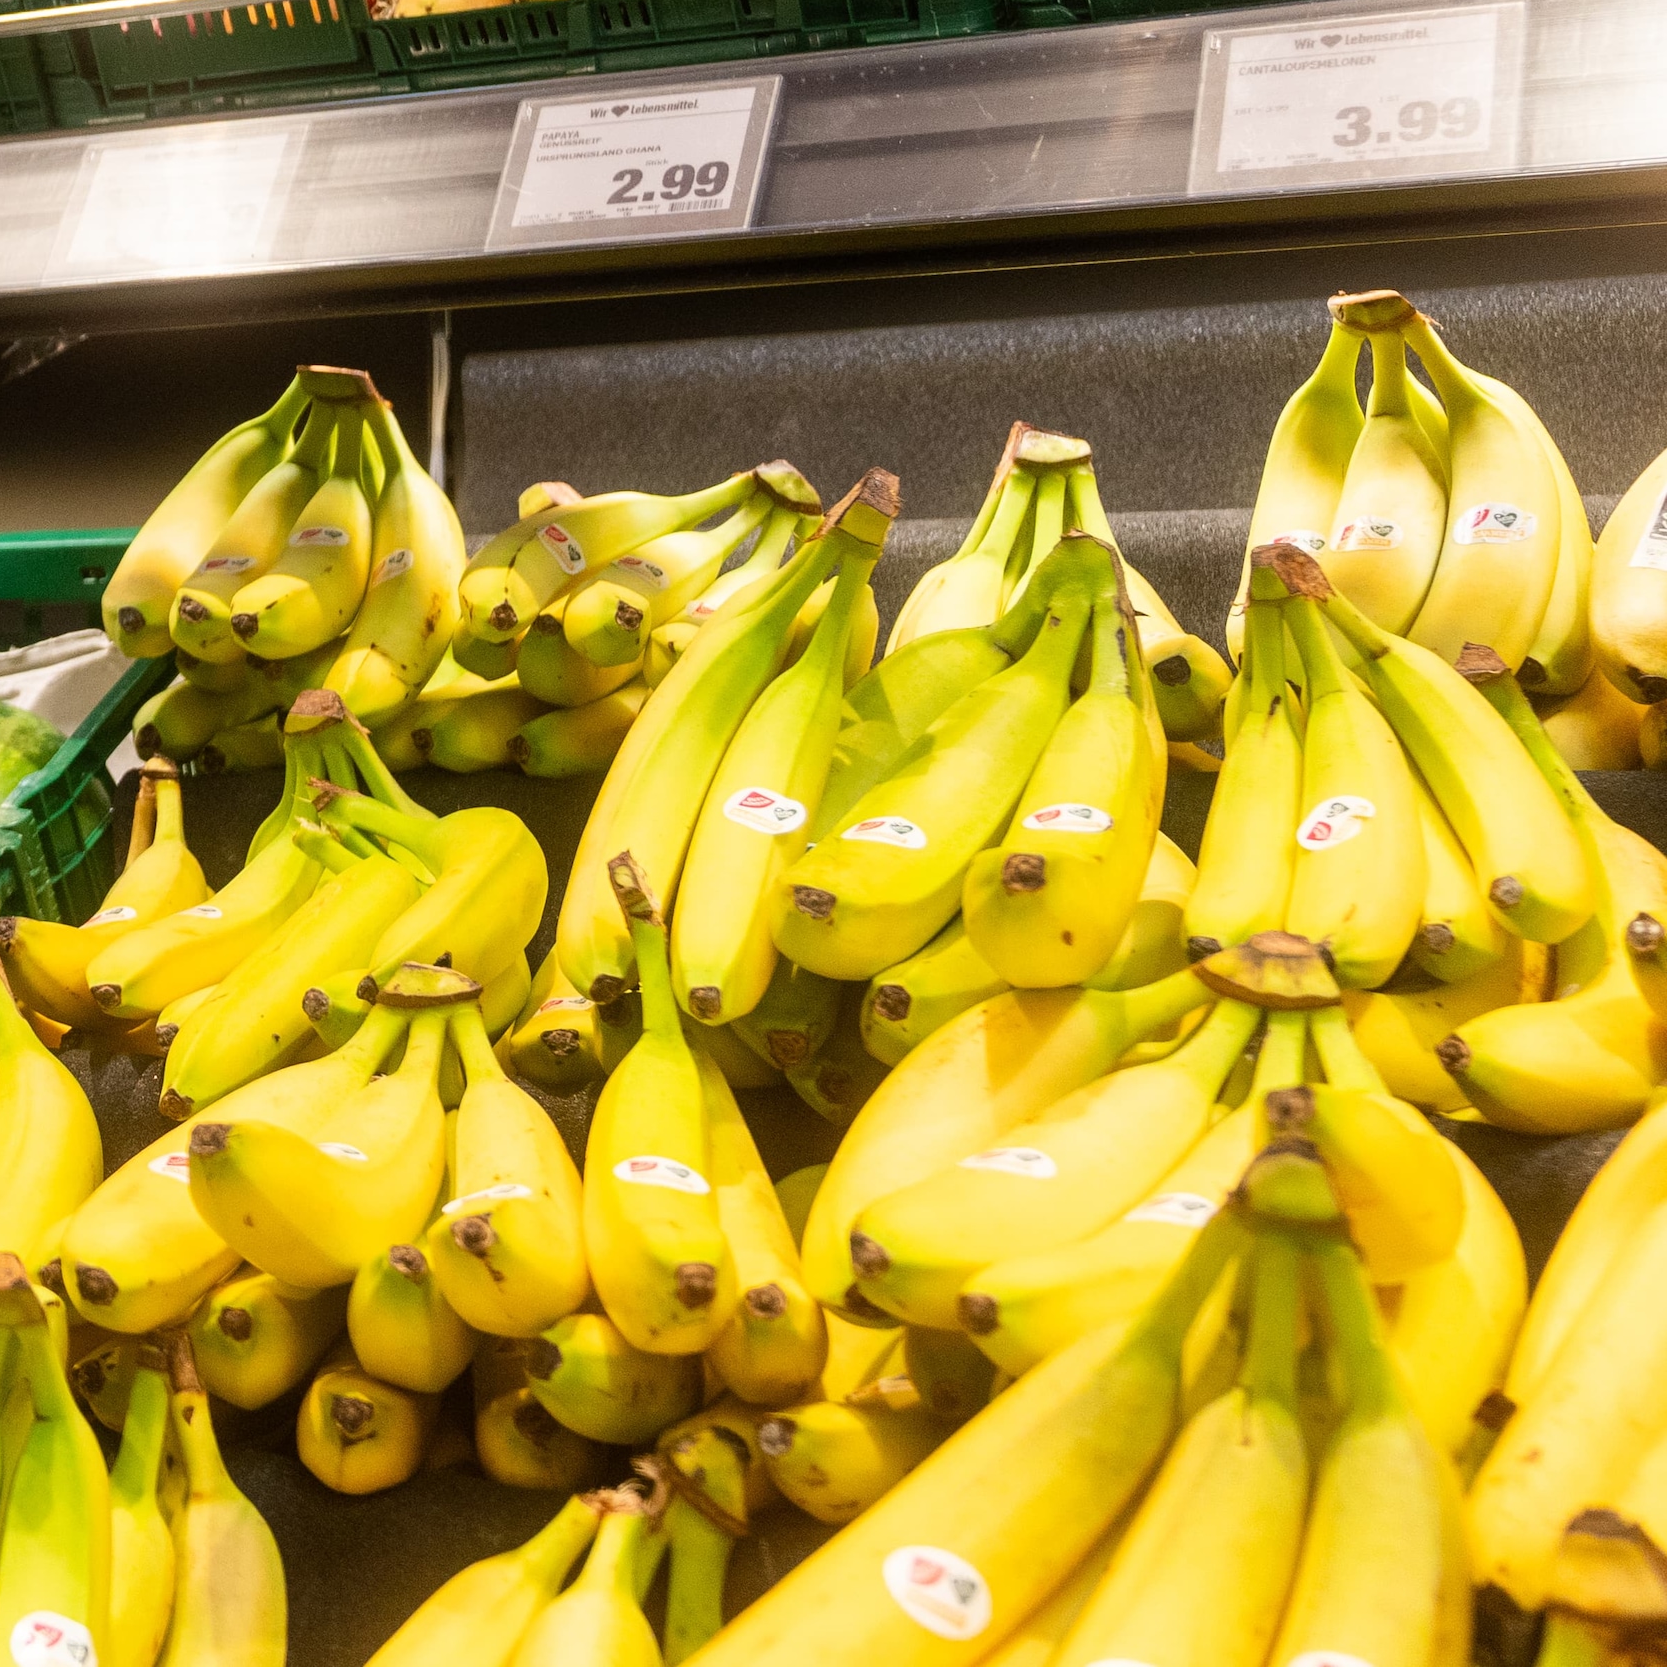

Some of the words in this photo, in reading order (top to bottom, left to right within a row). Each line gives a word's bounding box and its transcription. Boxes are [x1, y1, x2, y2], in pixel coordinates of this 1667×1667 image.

[1293, 38, 1316, 50] Wir
[1238, 55, 1376, 76] CANTALOUPSMELONEN
[589, 108, 607, 119] Wir
[1332, 96, 1482, 147] 3.99
[541, 130, 581, 141] PAPAYA
[536, 149, 624, 163] URSPRUNGSLAND
[625, 145, 662, 155] GHANA
[606, 160, 730, 205] 2.99
